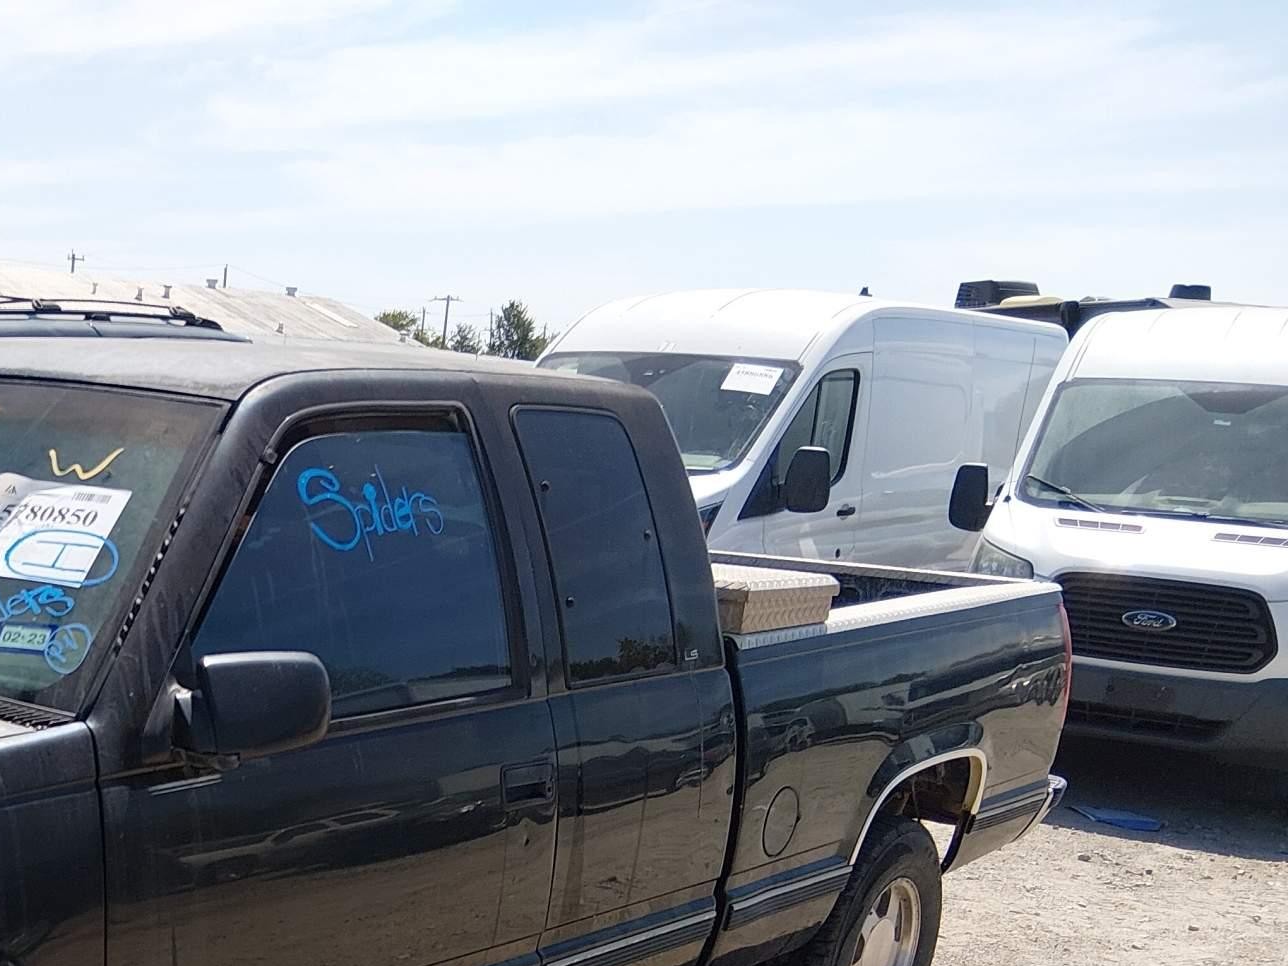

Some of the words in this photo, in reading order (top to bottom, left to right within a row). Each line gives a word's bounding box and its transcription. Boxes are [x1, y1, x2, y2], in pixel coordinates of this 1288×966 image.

[48, 448, 125, 481] W
[296, 463, 444, 562] Spiders
[1132, 612, 1165, 628] Ford
